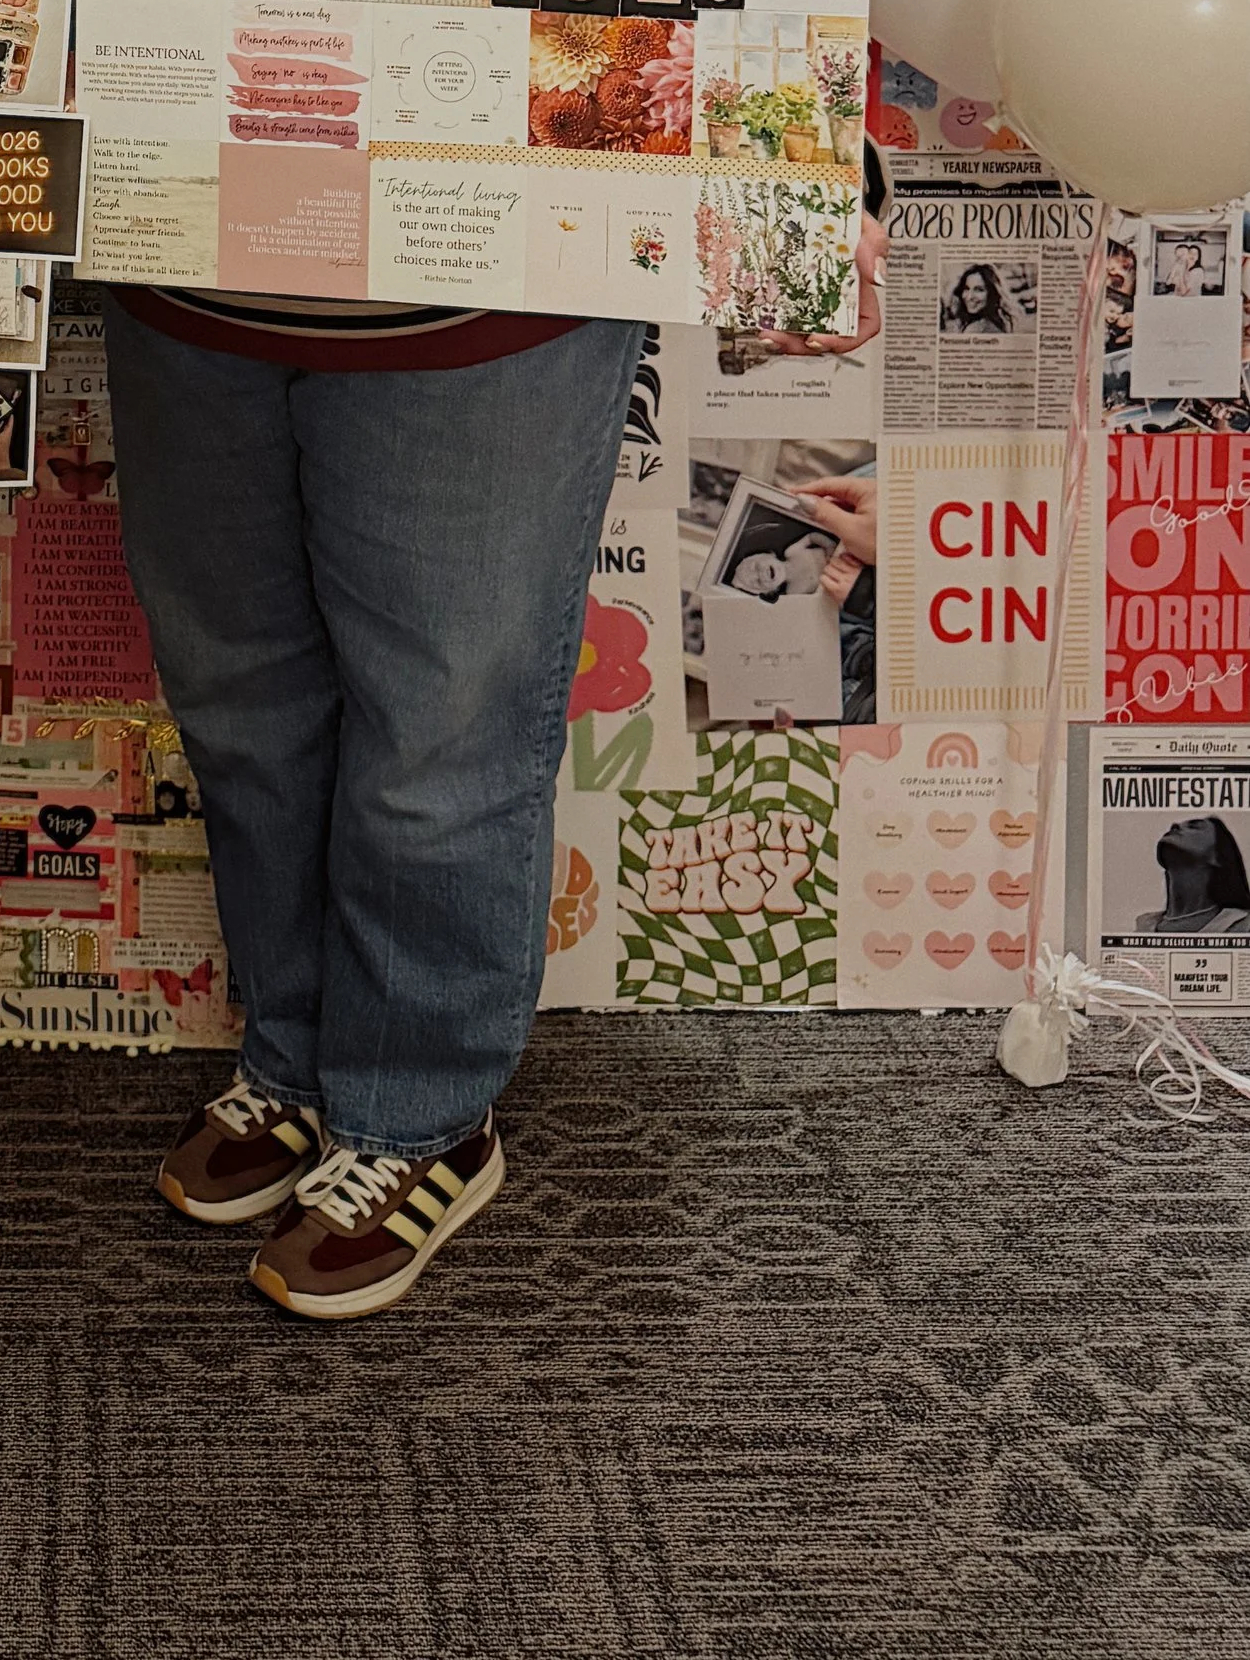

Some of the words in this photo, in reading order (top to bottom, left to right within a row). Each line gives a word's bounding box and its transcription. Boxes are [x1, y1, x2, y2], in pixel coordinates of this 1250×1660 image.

[95, 46, 110, 57] BE
[114, 46, 204, 61] INTENTIONAL
[943, 161, 979, 174] YEARLY
[982, 161, 1042, 175] NEWSPAPER
[7, 212, 52, 233] YOU
[888, 204, 955, 239] 2026
[961, 202, 1093, 239] PROMISES
[929, 501, 1047, 558] CIN
[929, 587, 1047, 642] CIN
[646, 813, 757, 867] TAKE
[761, 812, 814, 851] IT
[39, 856, 96, 876] GOALS
[646, 851, 811, 912] EASY
[0, 991, 174, 1036] Sunshine
